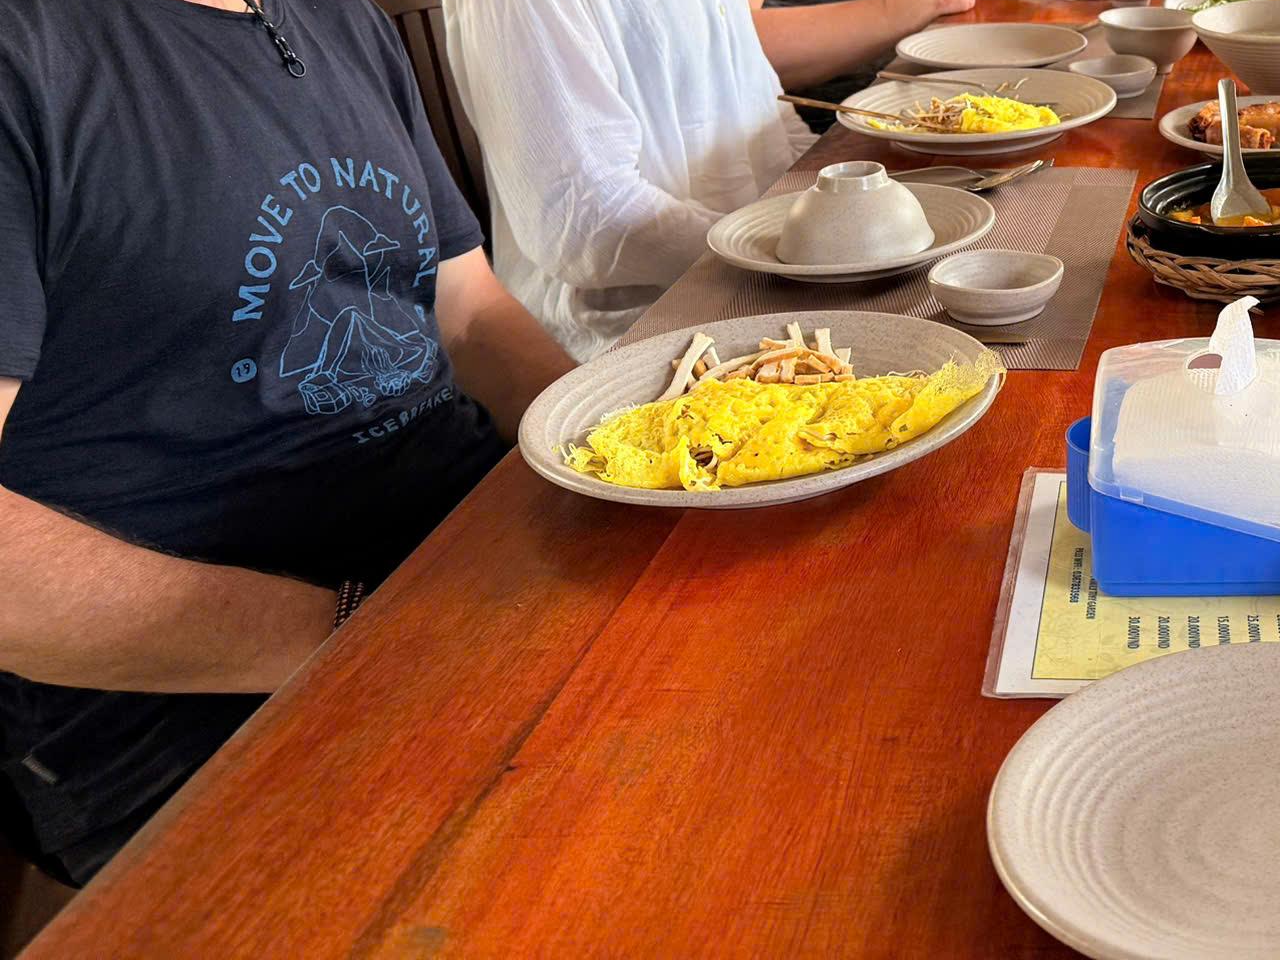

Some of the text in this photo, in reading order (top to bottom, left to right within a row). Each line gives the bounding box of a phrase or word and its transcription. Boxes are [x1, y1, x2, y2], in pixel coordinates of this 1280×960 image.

[231, 156, 437, 322] MOVE TO NATURAL
